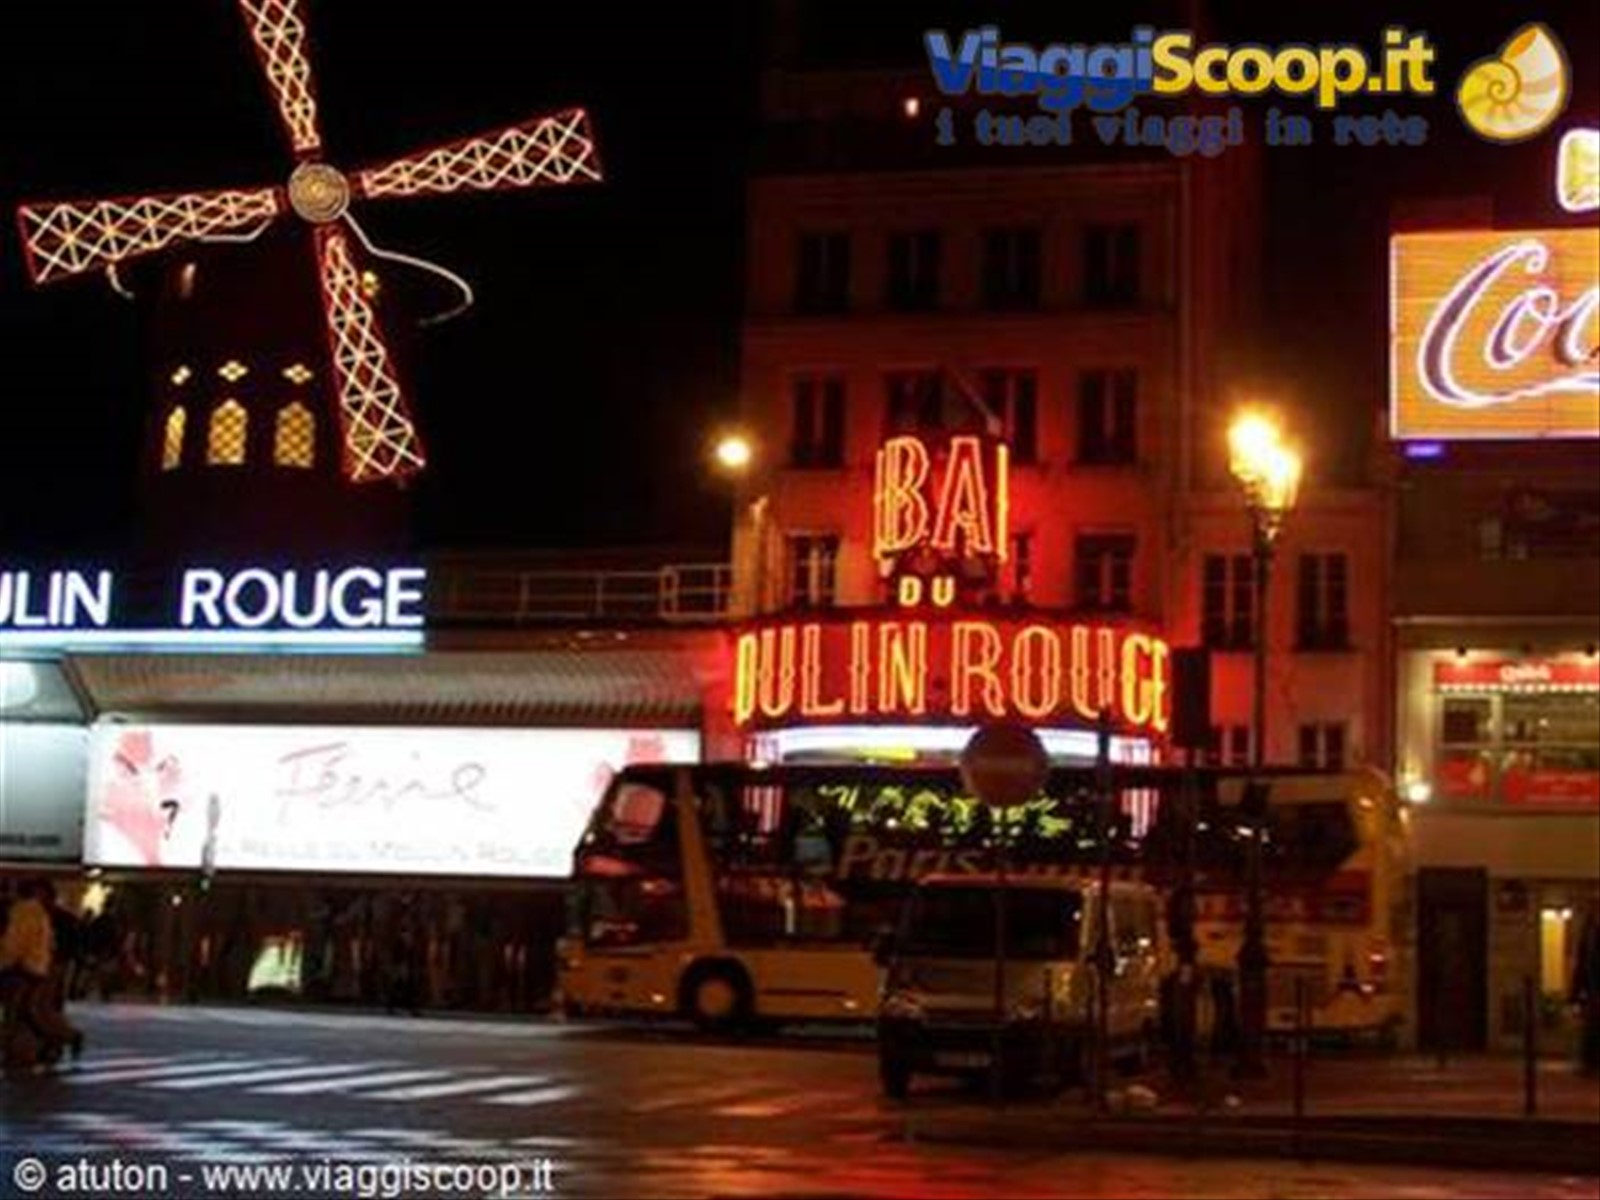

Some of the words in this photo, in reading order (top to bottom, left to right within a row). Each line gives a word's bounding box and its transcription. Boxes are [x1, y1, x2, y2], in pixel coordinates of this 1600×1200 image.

[0, 571, 111, 626] LIN
[180, 567, 426, 628] ROUGE
[899, 575, 956, 607] DU
[951, 621, 1168, 732] ROUGE
